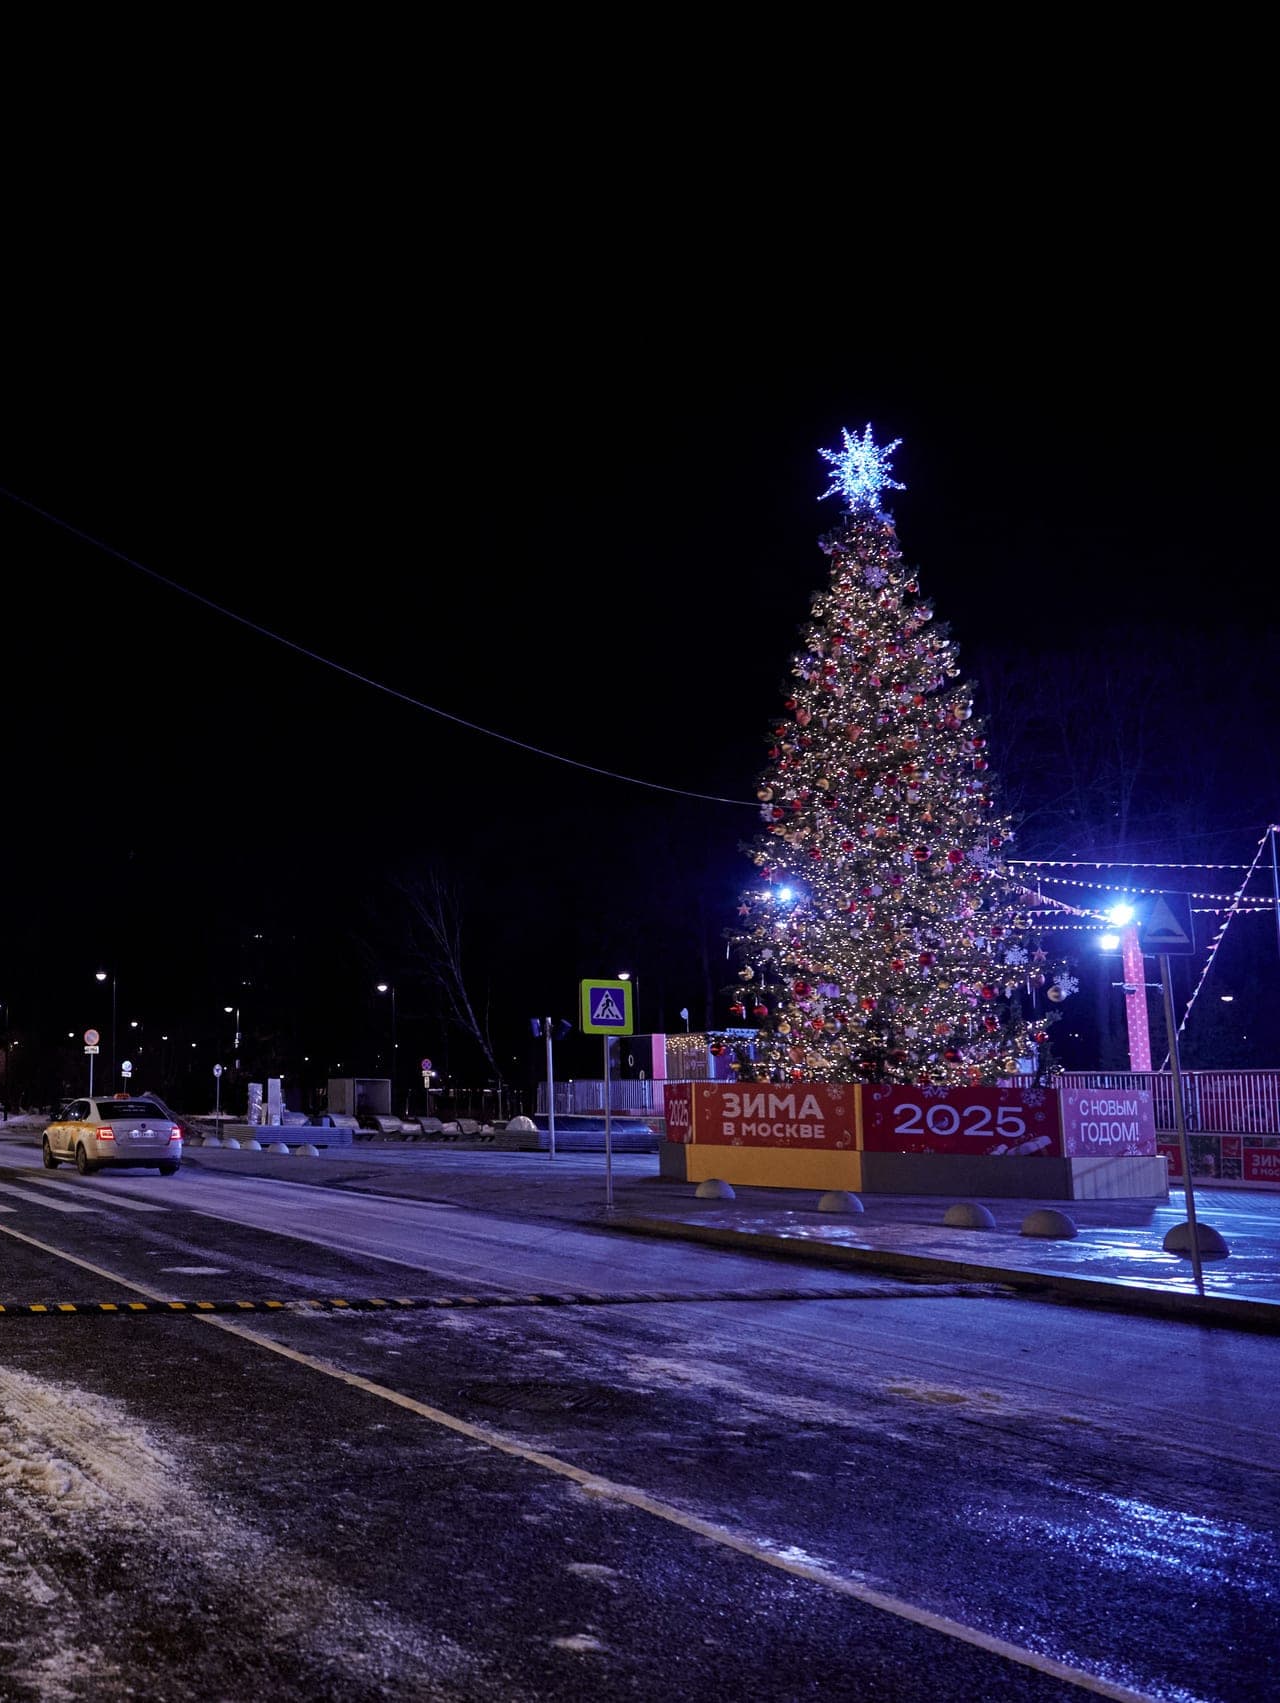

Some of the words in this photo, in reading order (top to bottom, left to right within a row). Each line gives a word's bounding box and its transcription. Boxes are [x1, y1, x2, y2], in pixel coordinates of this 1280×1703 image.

[669, 1100, 689, 1127] 2025
[722, 1093, 825, 1120] ЗИМА
[1080, 1100, 1089, 1116] С
[1091, 1100, 1138, 1116] НОВЫМ
[723, 1122, 735, 1136] В
[741, 1122, 825, 1139] МОСКВЕ
[893, 1103, 1026, 1138] 2025
[1080, 1122, 1139, 1145] ГОДОМ!
